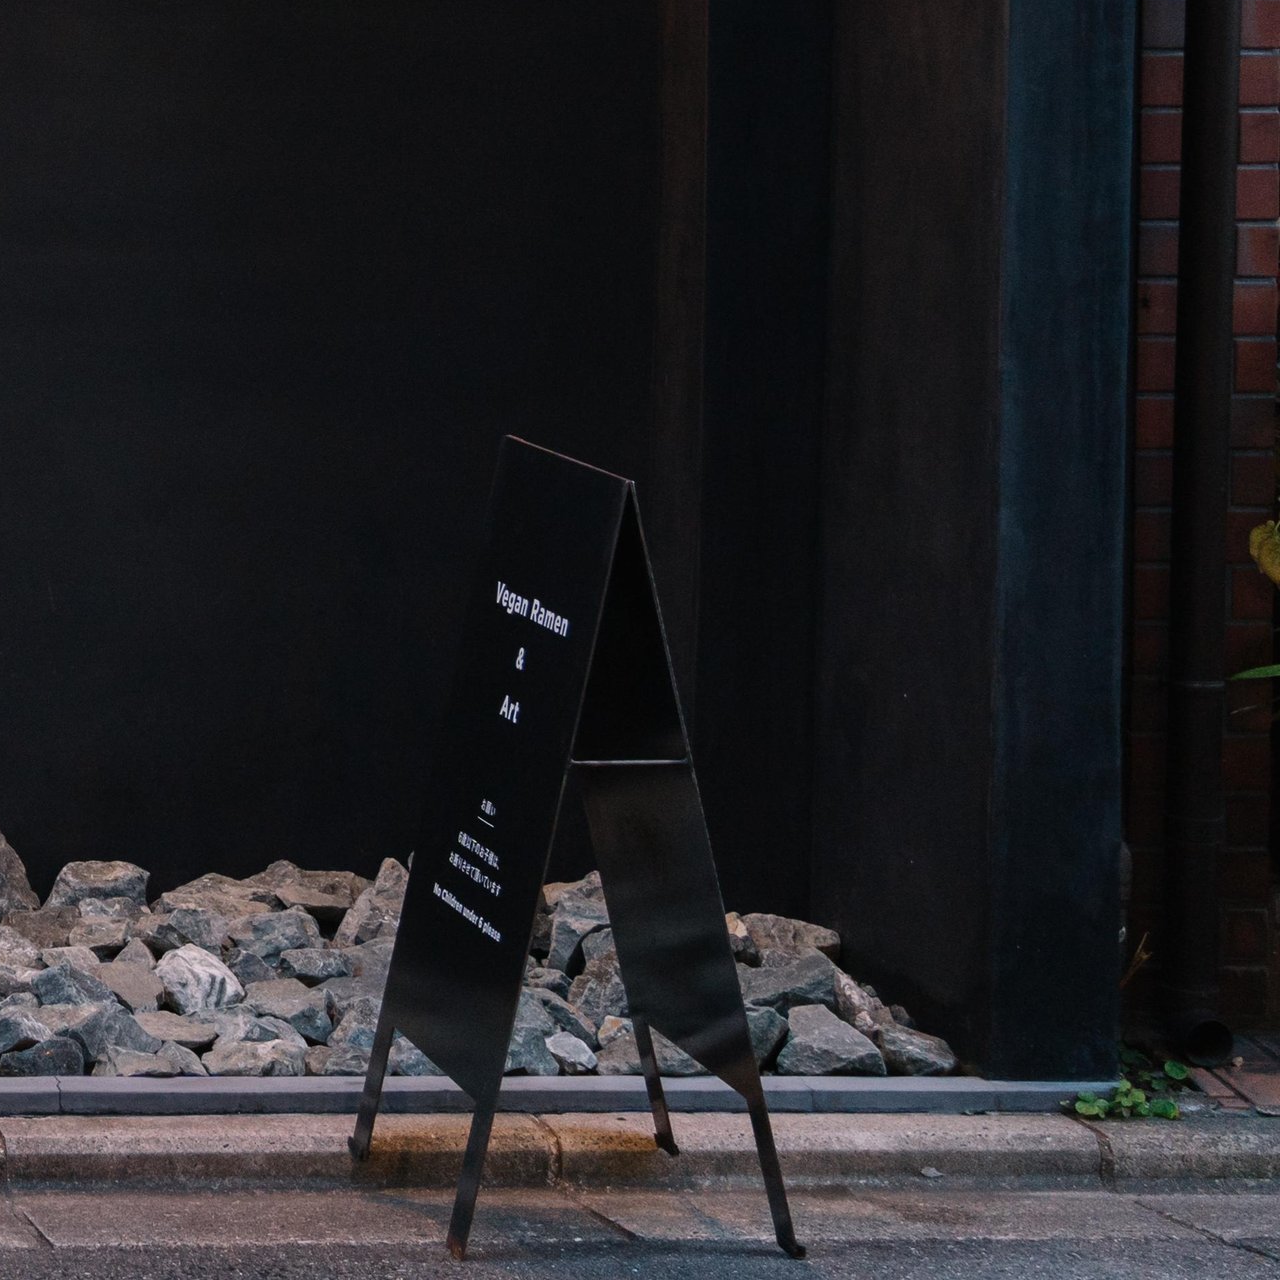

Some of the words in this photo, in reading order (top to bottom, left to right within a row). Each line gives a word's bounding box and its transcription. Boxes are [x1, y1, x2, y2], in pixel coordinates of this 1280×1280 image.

[496, 581, 529, 617] Vegan
[530, 599, 569, 637] Ramen
[515, 647, 525, 670] &
[499, 695, 520, 723] Art
[480, 798, 496, 816] お願い
[433, 882, 442, 897] No
[441, 889, 463, 914] Children
[462, 906, 479, 925] under
[478, 916, 484, 928] 6
[482, 921, 501, 942] please
